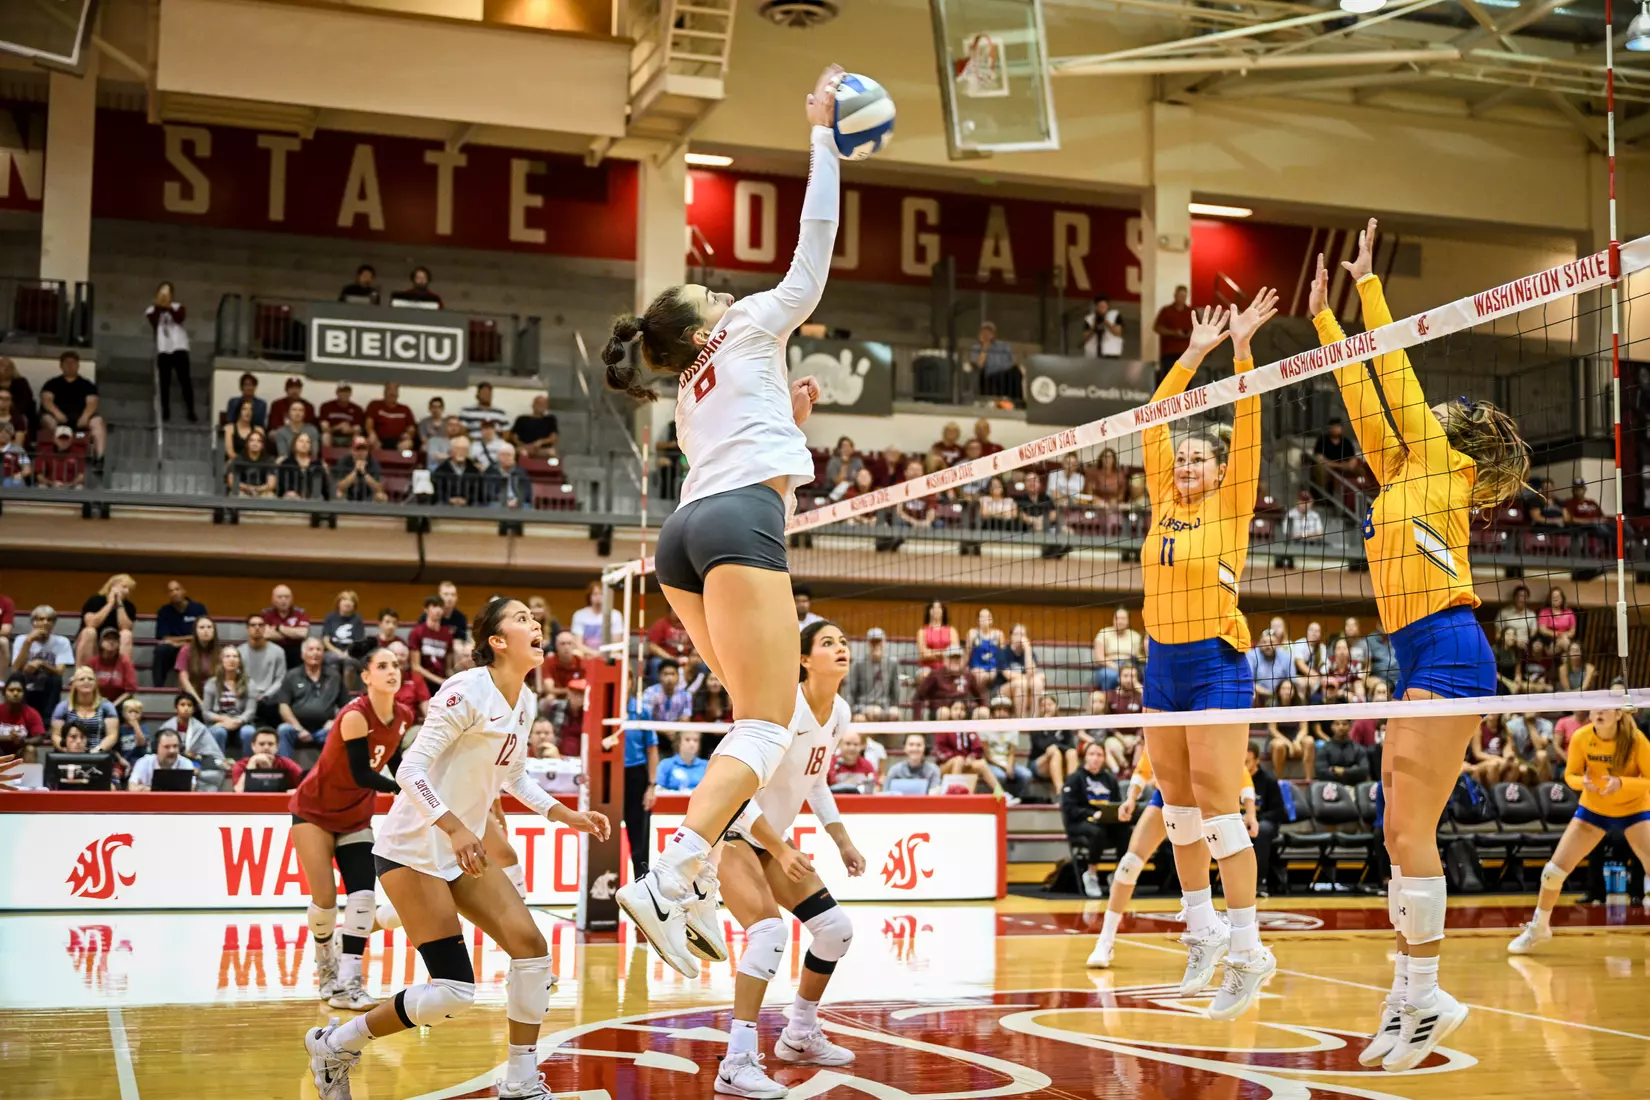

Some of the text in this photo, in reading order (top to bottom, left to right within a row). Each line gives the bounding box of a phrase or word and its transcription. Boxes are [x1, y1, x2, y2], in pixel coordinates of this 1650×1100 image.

[163, 124, 548, 244] STATE
[1474, 252, 1607, 317] WASHINGTON STATE
[1279, 331, 1377, 379] WASHINGTON STATE
[1134, 387, 1207, 426] WASHINGTON STATE
[1160, 536, 1175, 566] 11
[370, 745, 385, 768] 3
[495, 733, 517, 766] 12
[804, 746, 826, 775] 18
[414, 779, 441, 809] COUGARS
